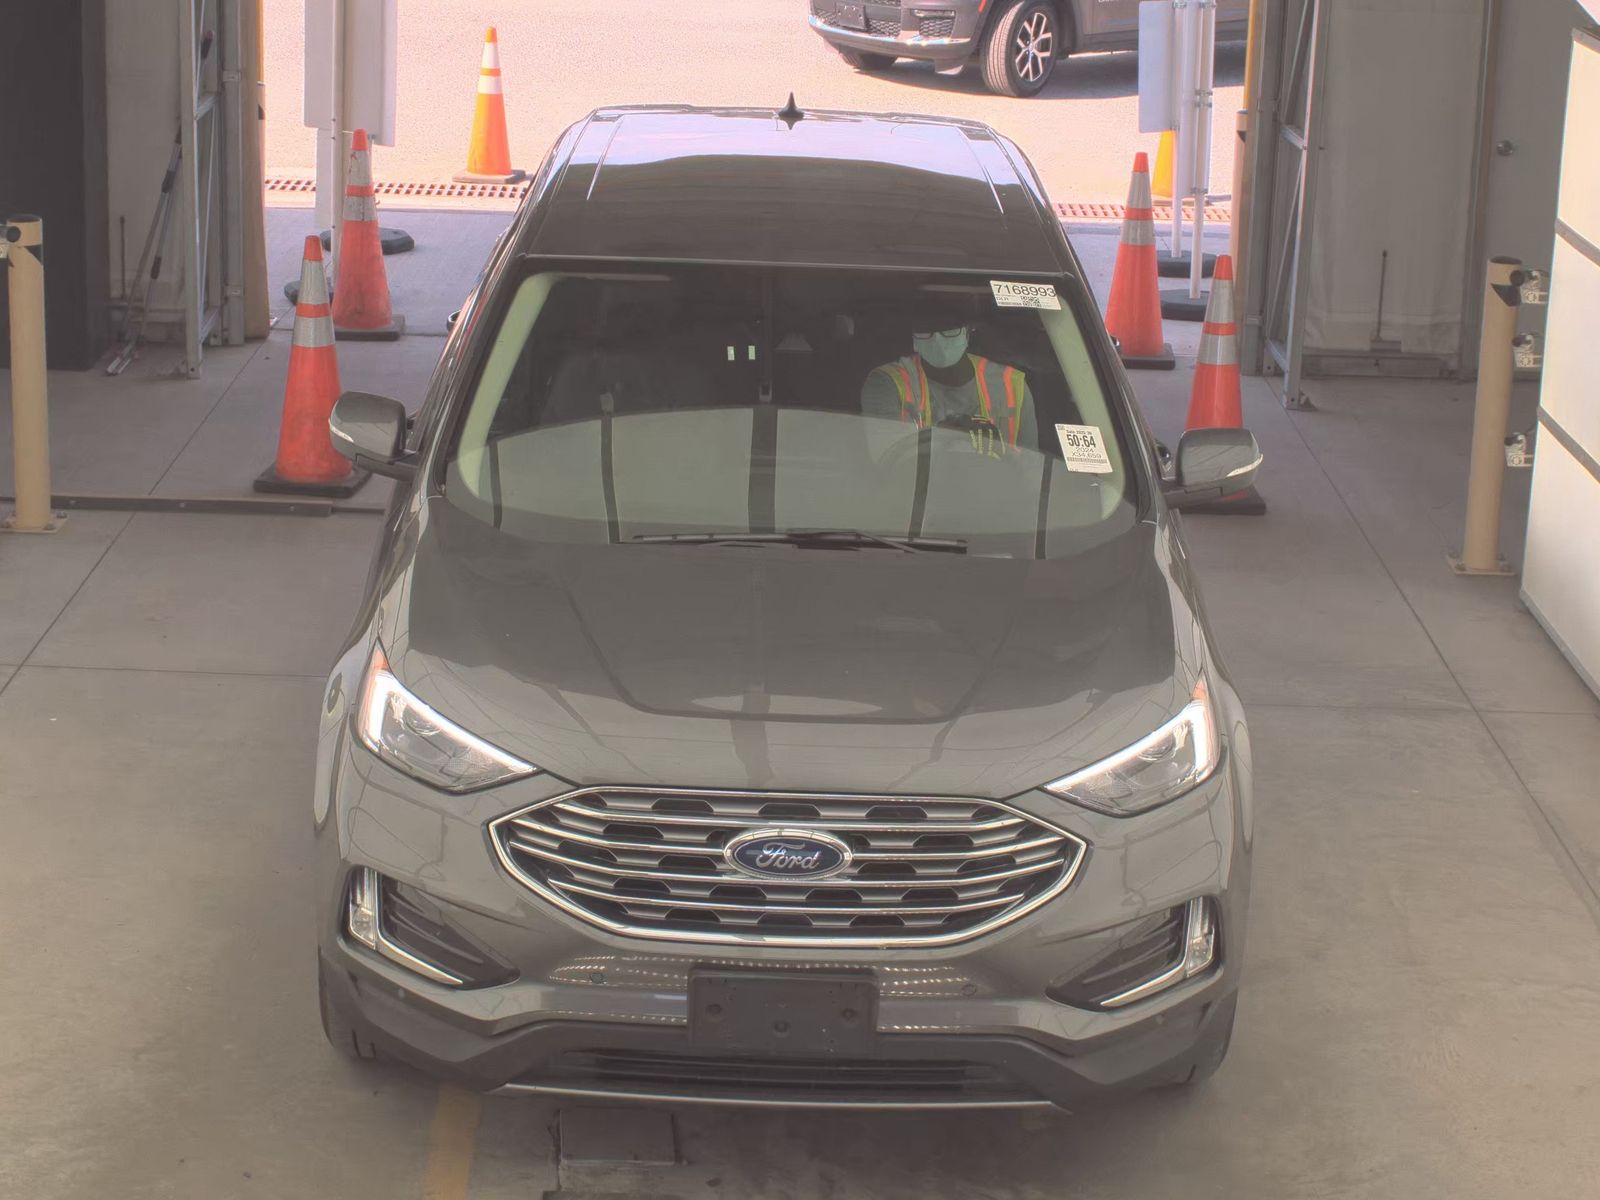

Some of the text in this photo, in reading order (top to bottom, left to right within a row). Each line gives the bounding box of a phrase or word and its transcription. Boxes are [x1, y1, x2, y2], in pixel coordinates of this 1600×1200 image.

[993, 283, 1057, 297] 7168993
[1067, 434, 1096, 448] 50:64
[755, 842, 822, 869] Ford
